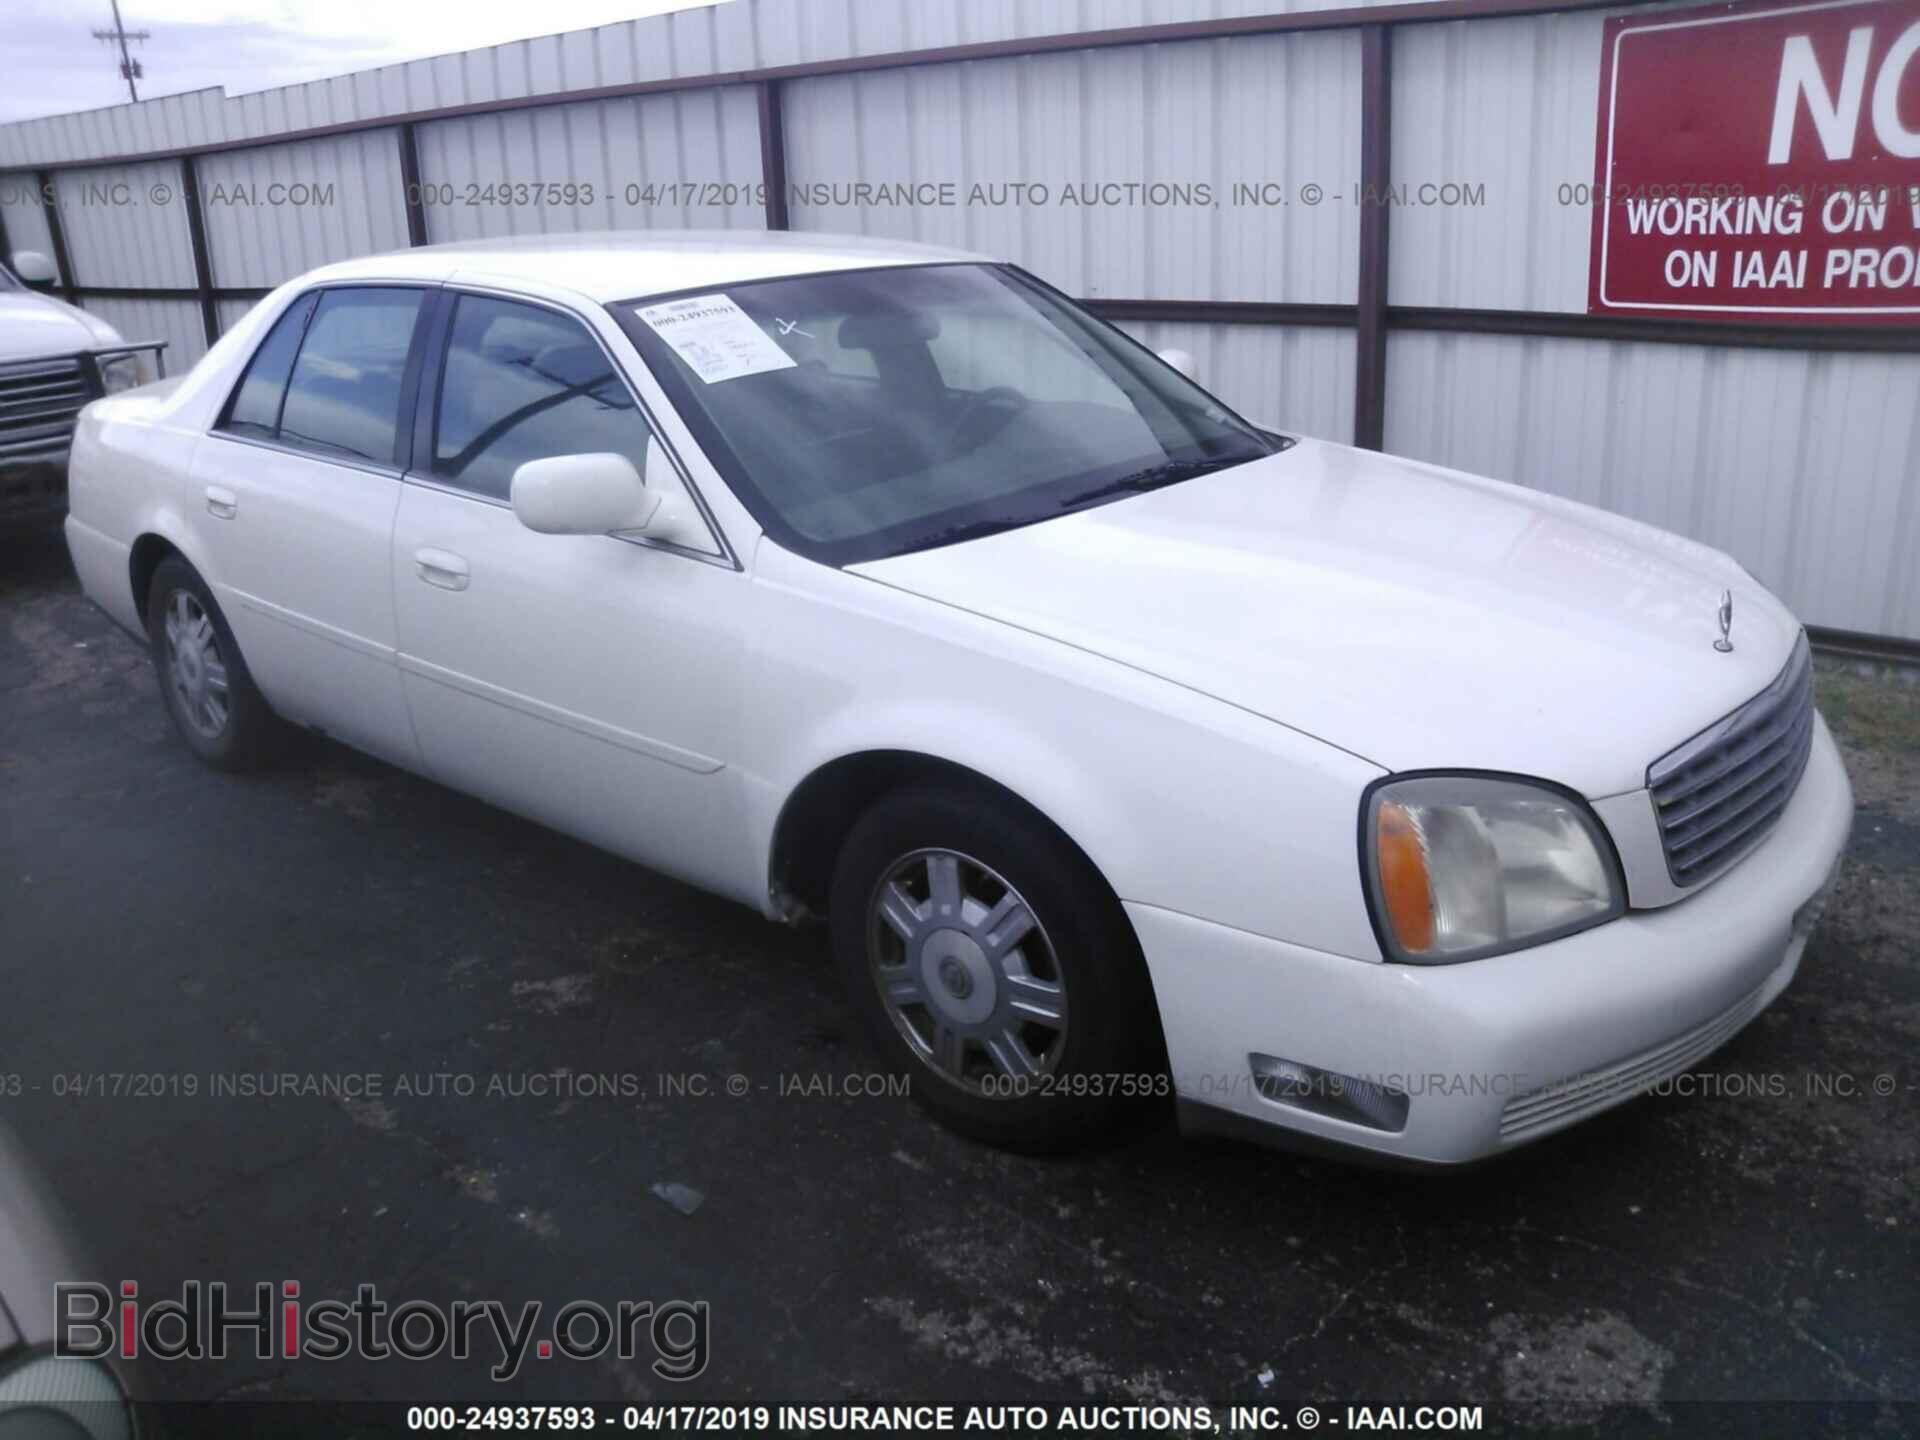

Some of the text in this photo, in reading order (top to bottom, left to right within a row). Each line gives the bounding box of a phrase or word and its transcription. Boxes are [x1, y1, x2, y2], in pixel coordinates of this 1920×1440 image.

[1627, 193, 1803, 235] WORKING
[1822, 190, 1888, 233] ON
[1664, 250, 1718, 287] ON
[1732, 250, 1808, 288] IAAI
